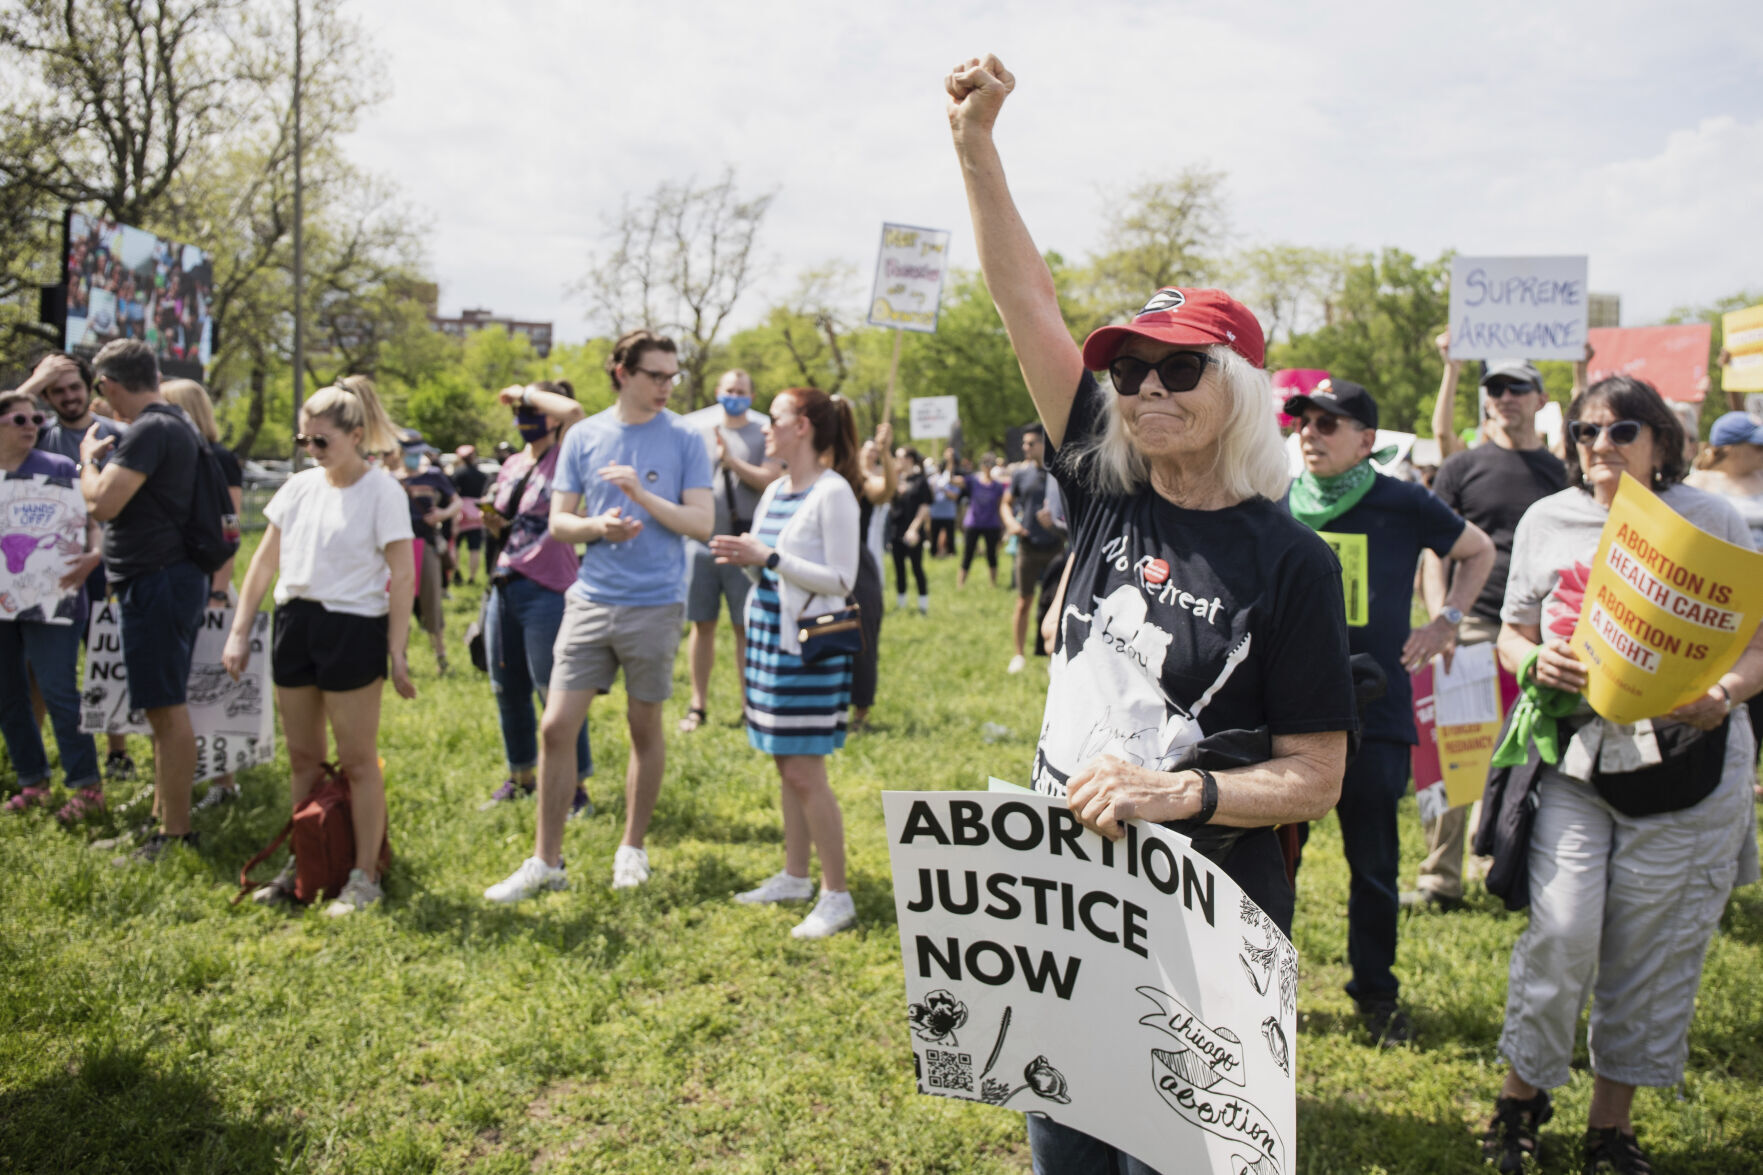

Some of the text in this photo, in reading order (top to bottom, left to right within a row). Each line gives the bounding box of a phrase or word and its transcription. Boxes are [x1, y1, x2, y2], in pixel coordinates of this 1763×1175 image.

[1464, 268, 1580, 307] SUPREME
[1101, 535, 1129, 572] No
[1616, 523, 1733, 605] ABORTION IS
[1597, 584, 1709, 660] ABORTION IS
[1610, 548, 1736, 630] HEALTH CARE.
[1592, 609, 1655, 671] A RIGHT.
[907, 868, 1149, 959] JUSTICE
[915, 935, 1082, 1000] NOW
